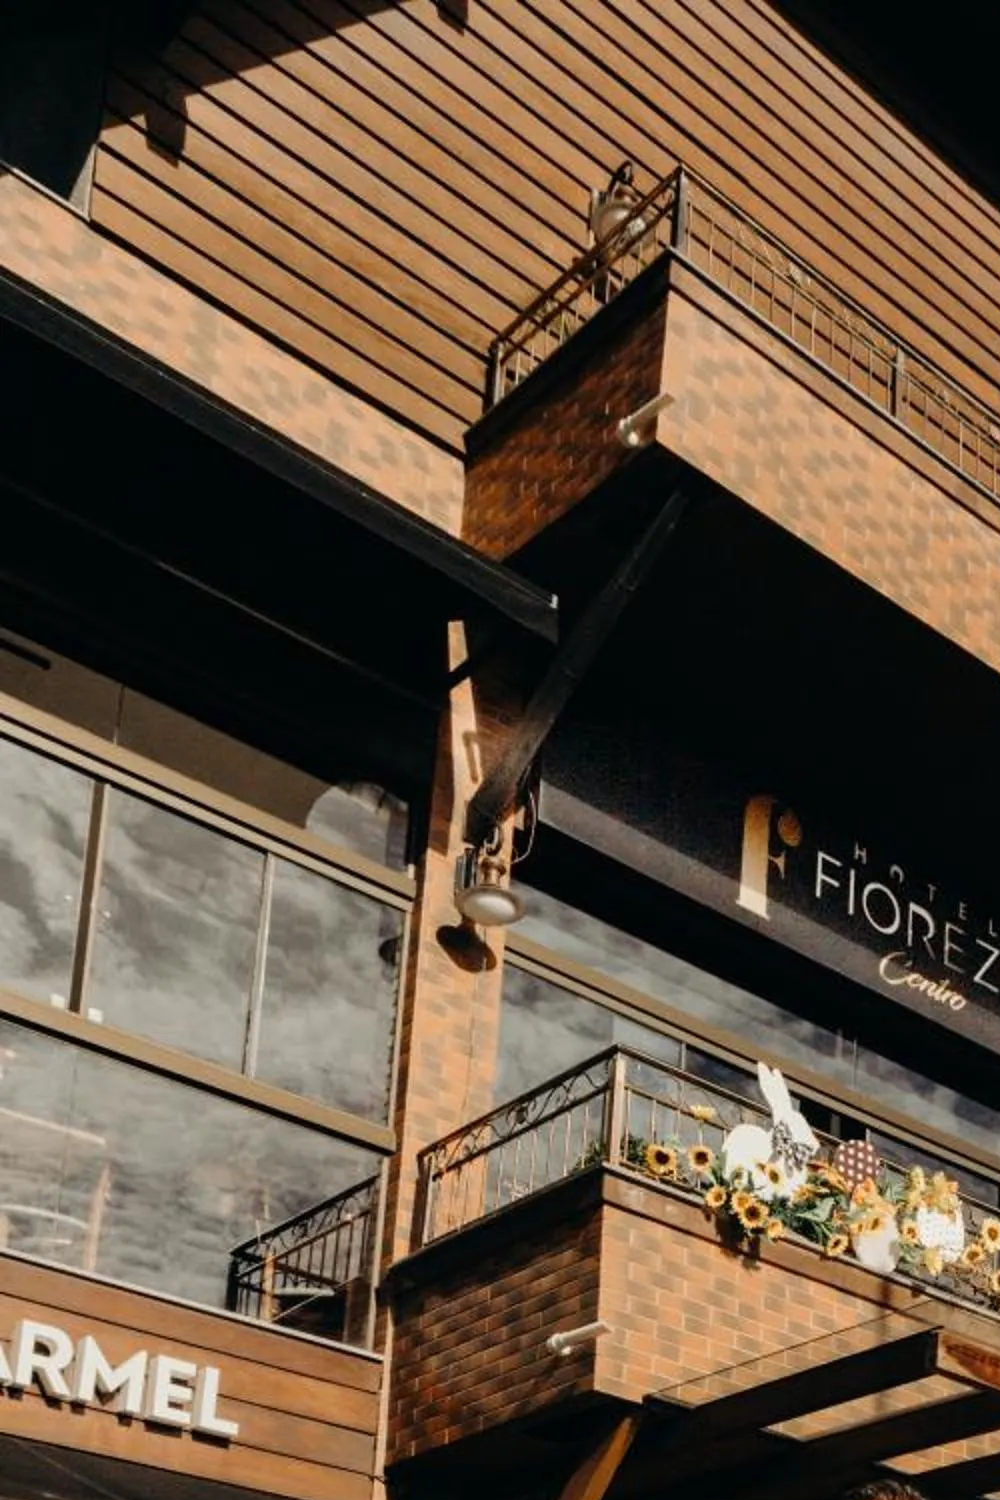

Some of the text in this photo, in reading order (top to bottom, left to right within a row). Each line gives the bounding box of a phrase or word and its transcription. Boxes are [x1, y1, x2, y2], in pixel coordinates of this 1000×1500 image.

[854, 842, 997, 937] HOTEL
[879, 951, 967, 1011] Centro
[0, 1317, 239, 1437] RMEL
